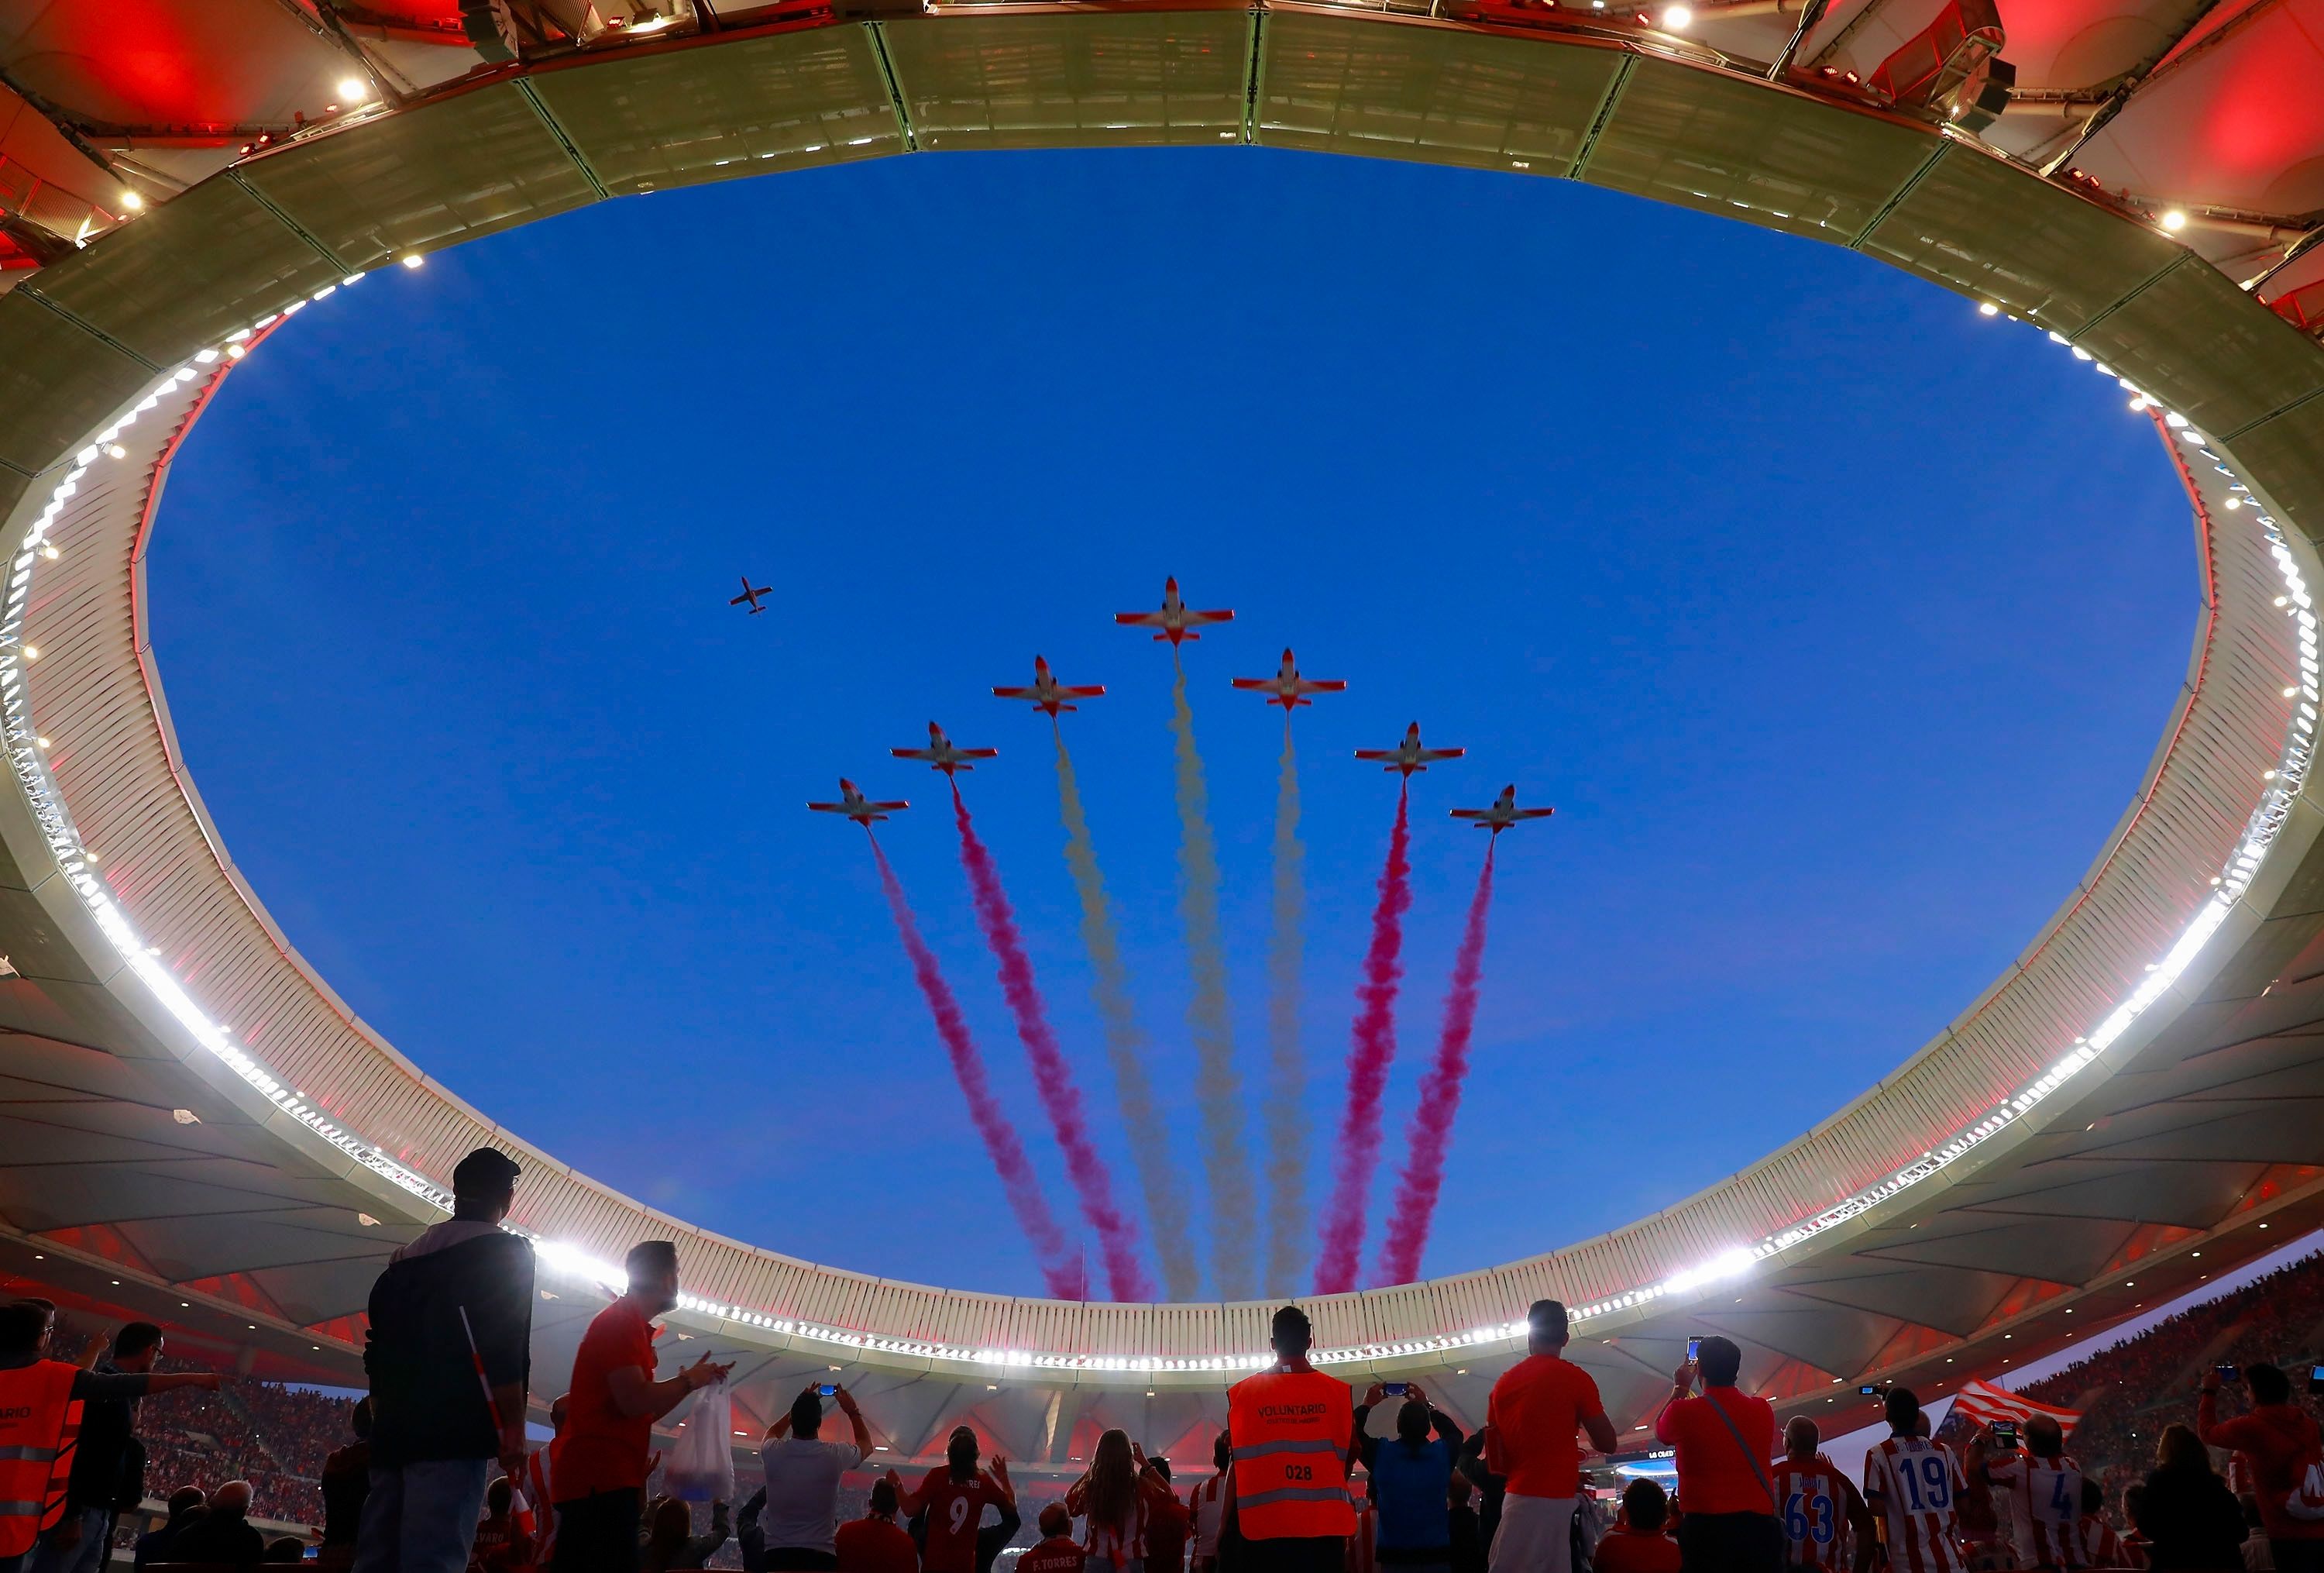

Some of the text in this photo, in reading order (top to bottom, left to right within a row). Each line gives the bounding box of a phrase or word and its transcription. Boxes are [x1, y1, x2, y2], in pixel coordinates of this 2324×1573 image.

[1257, 1403, 1326, 1418] VOLUNTARIO
[1658, 1450, 1674, 1458] OLED
[1285, 1465, 1312, 1481] 028
[1899, 1457, 1949, 1510] 19
[2050, 1474, 2073, 1520] 4
[949, 1496, 969, 1535] 9
[1785, 1493, 1834, 1543] 63
[1042, 1556, 1077, 1570] TORRES
